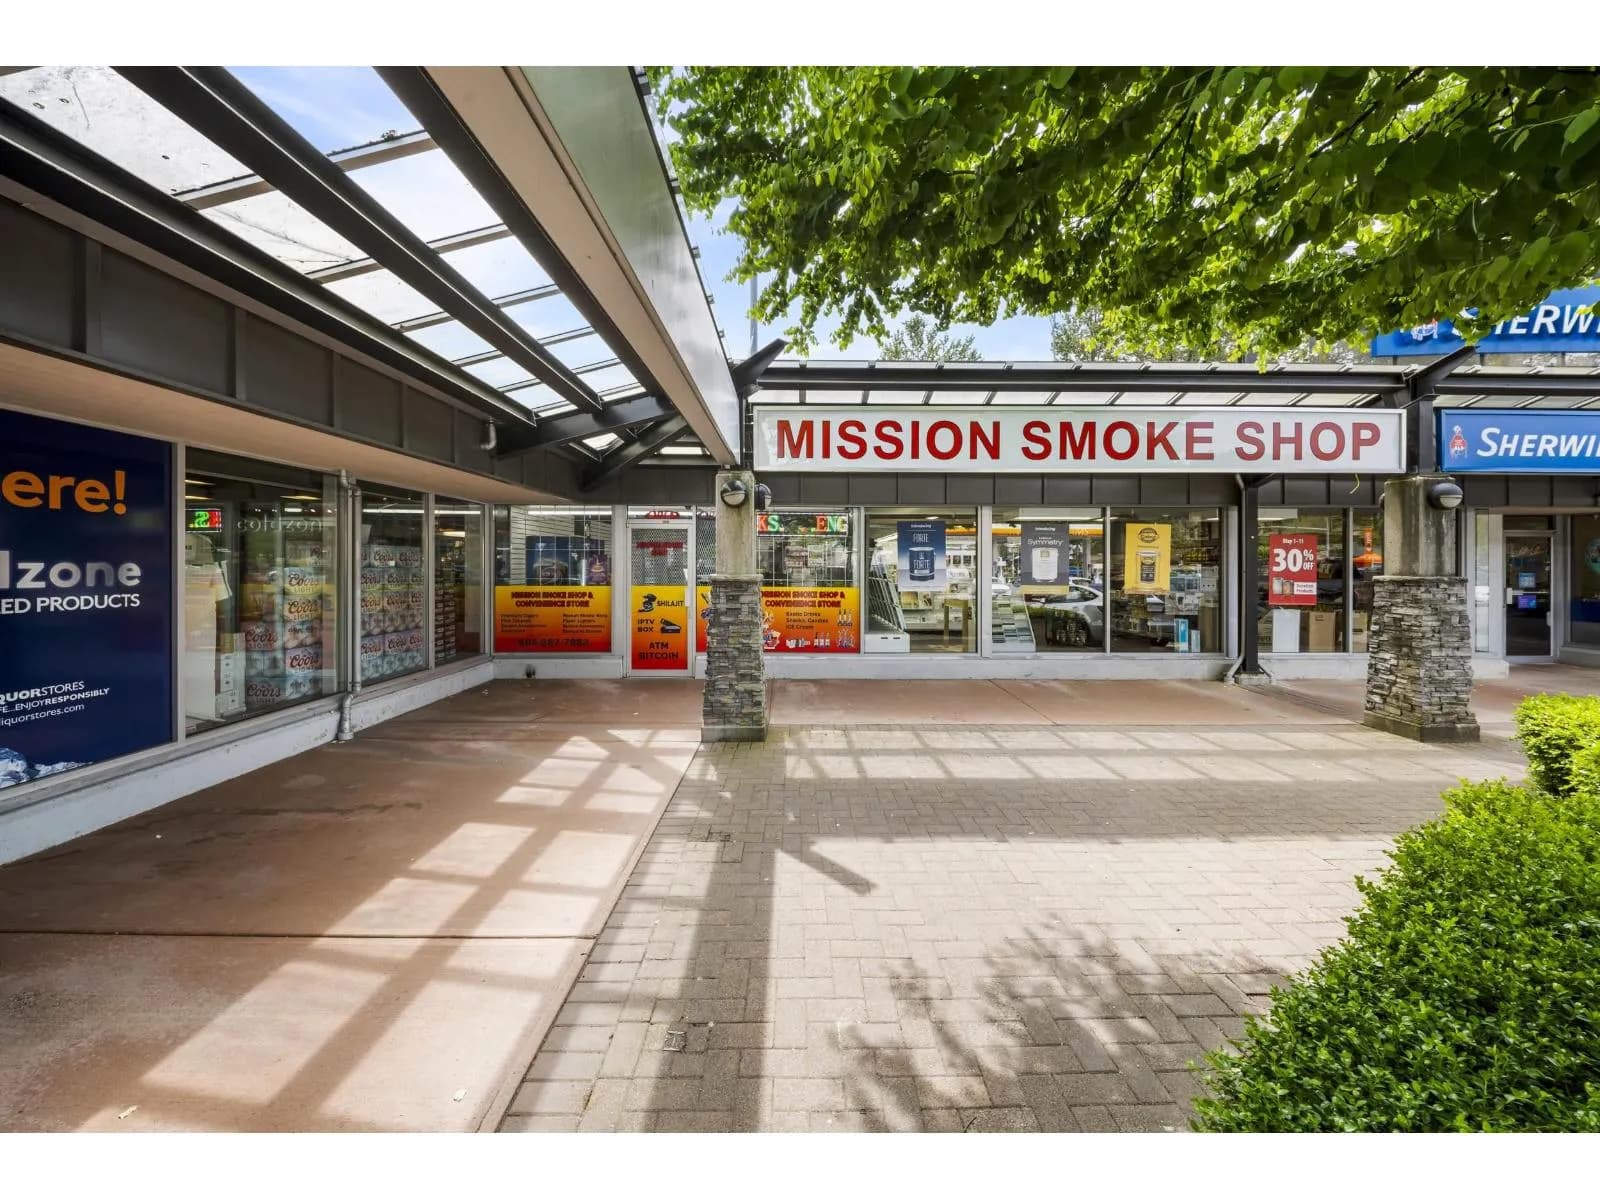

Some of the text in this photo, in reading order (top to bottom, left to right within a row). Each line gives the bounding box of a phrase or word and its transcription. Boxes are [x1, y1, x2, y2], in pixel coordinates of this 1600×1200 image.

[1452, 304, 1600, 336] ERW
[776, 420, 1381, 461] MISSION SMOKE SHOP
[1477, 427, 1600, 457] SHERWI
[2, 471, 127, 514] ere!
[1303, 562, 1314, 571] OFF
[0, 593, 141, 614] ED PRODUCTS
[638, 651, 679, 660] BITCOIN
[649, 641, 669, 650] ATM
